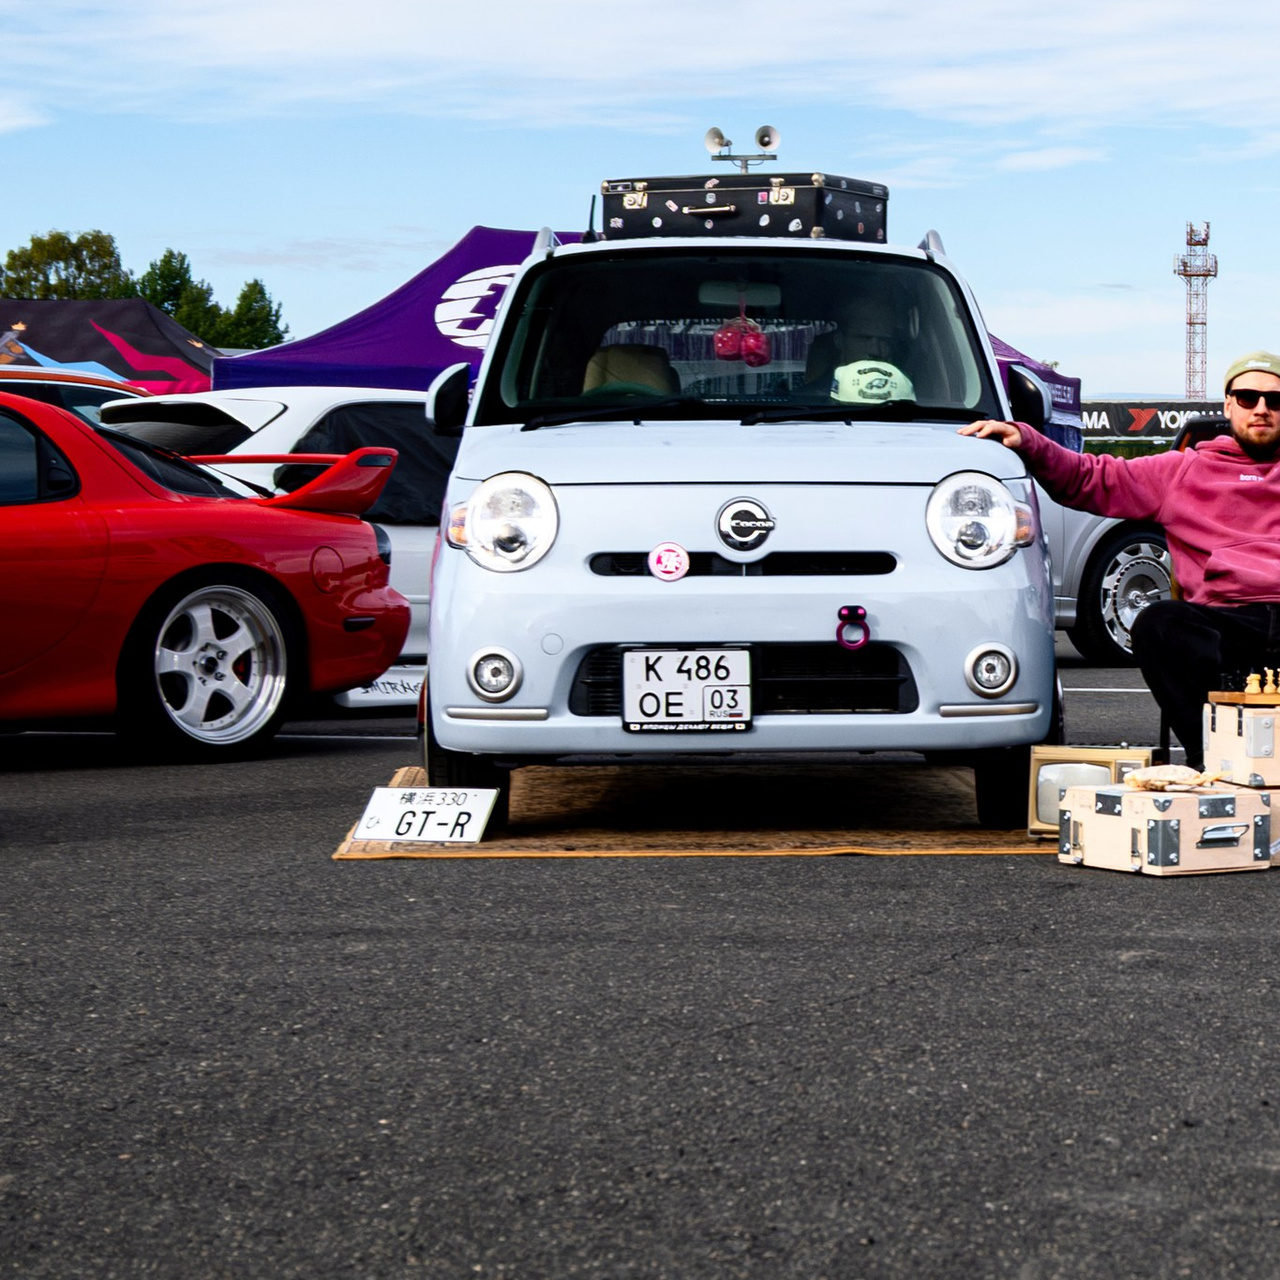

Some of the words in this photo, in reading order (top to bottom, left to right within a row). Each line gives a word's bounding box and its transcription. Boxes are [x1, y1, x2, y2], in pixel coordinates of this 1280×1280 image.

[1081, 411, 1110, 429] MA
[676, 655, 730, 681] 486
[711, 689, 738, 709] 03
[395, 810, 472, 838] GT-R
